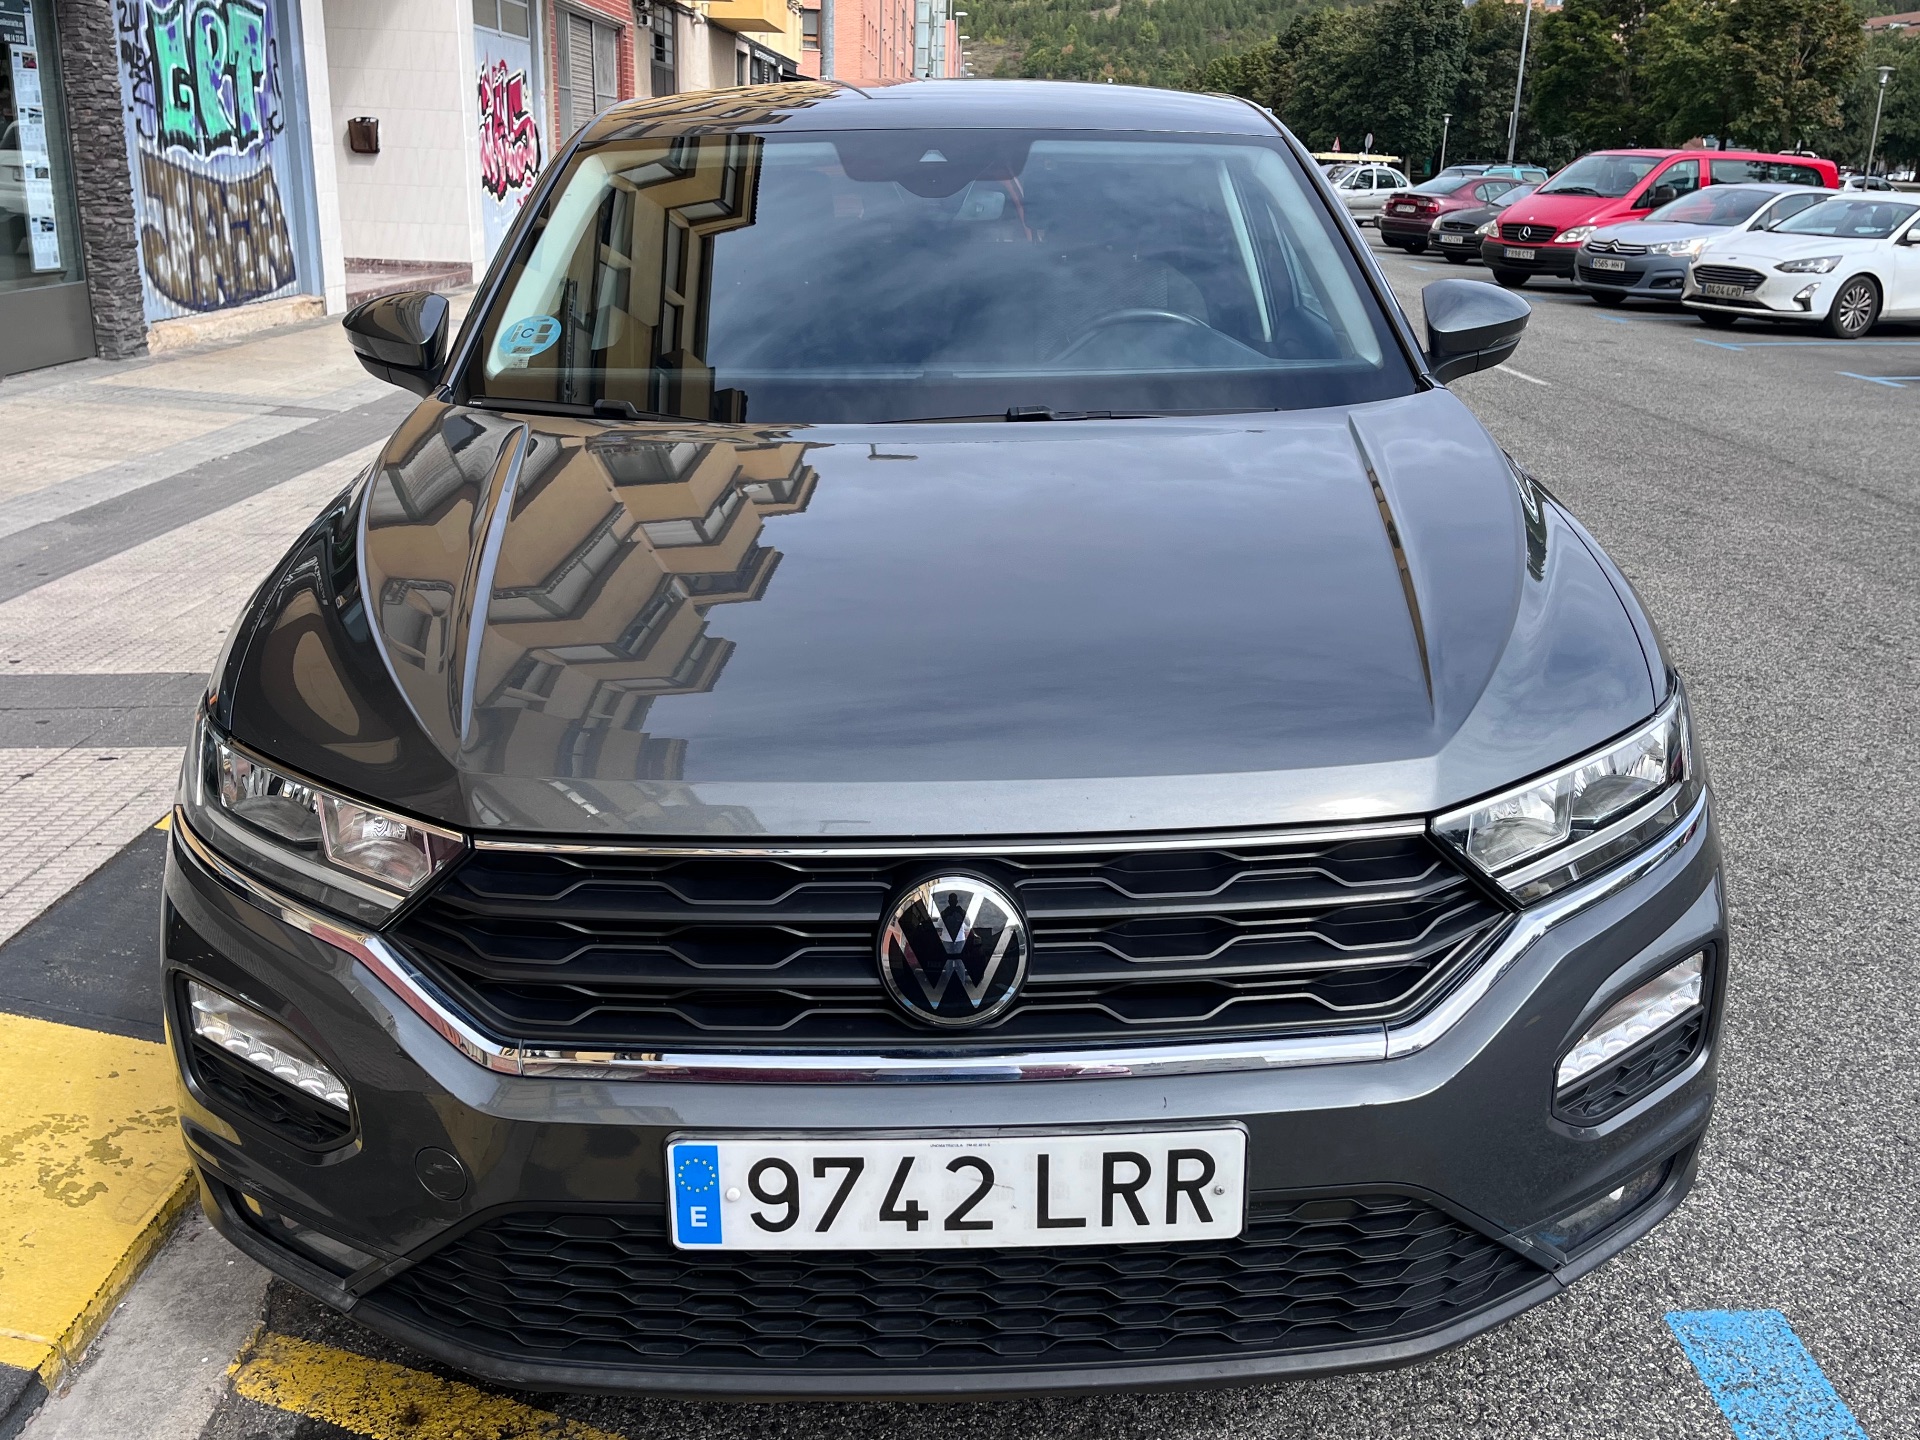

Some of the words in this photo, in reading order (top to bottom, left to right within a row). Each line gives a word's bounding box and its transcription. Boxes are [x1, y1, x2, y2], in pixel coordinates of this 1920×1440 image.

[1707, 284, 1725, 295] 0424
[521, 328, 535, 338] C
[747, 1156, 996, 1233] 9742
[1037, 1149, 1217, 1228] LRR
[690, 1206, 708, 1228] E
